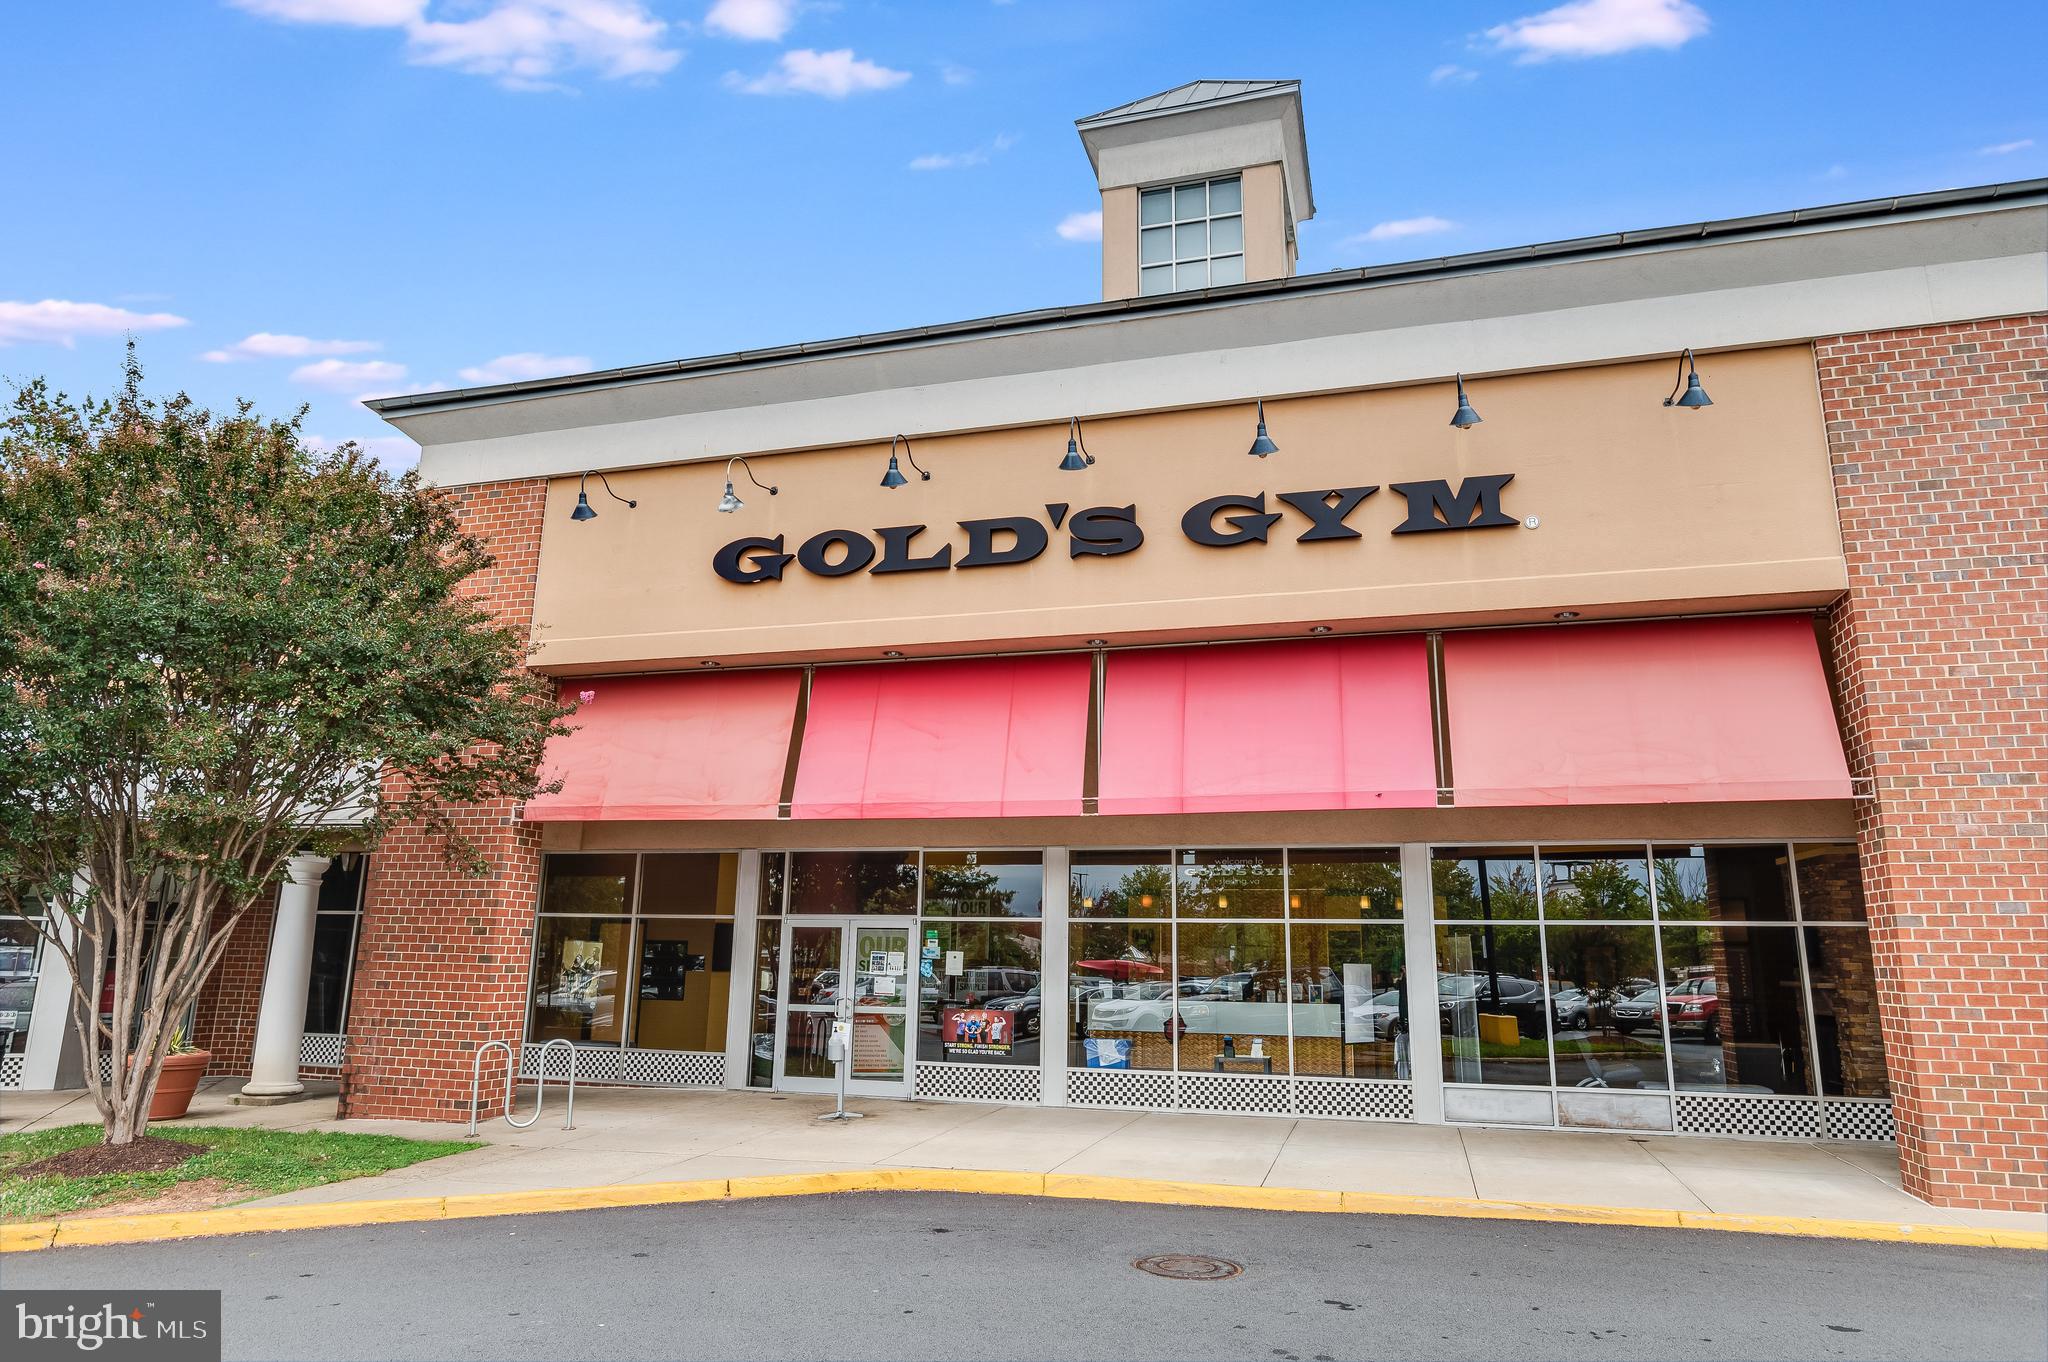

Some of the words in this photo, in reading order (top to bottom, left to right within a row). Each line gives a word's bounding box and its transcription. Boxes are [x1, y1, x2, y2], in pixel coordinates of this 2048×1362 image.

[712, 502, 1145, 584] GOLD'S
[1181, 473, 1521, 549] GYM
[1214, 857, 1253, 865] welcome
[1255, 857, 1264, 865] to
[1184, 867, 1248, 876] GOLD'S
[960, 900, 987, 914] OUR
